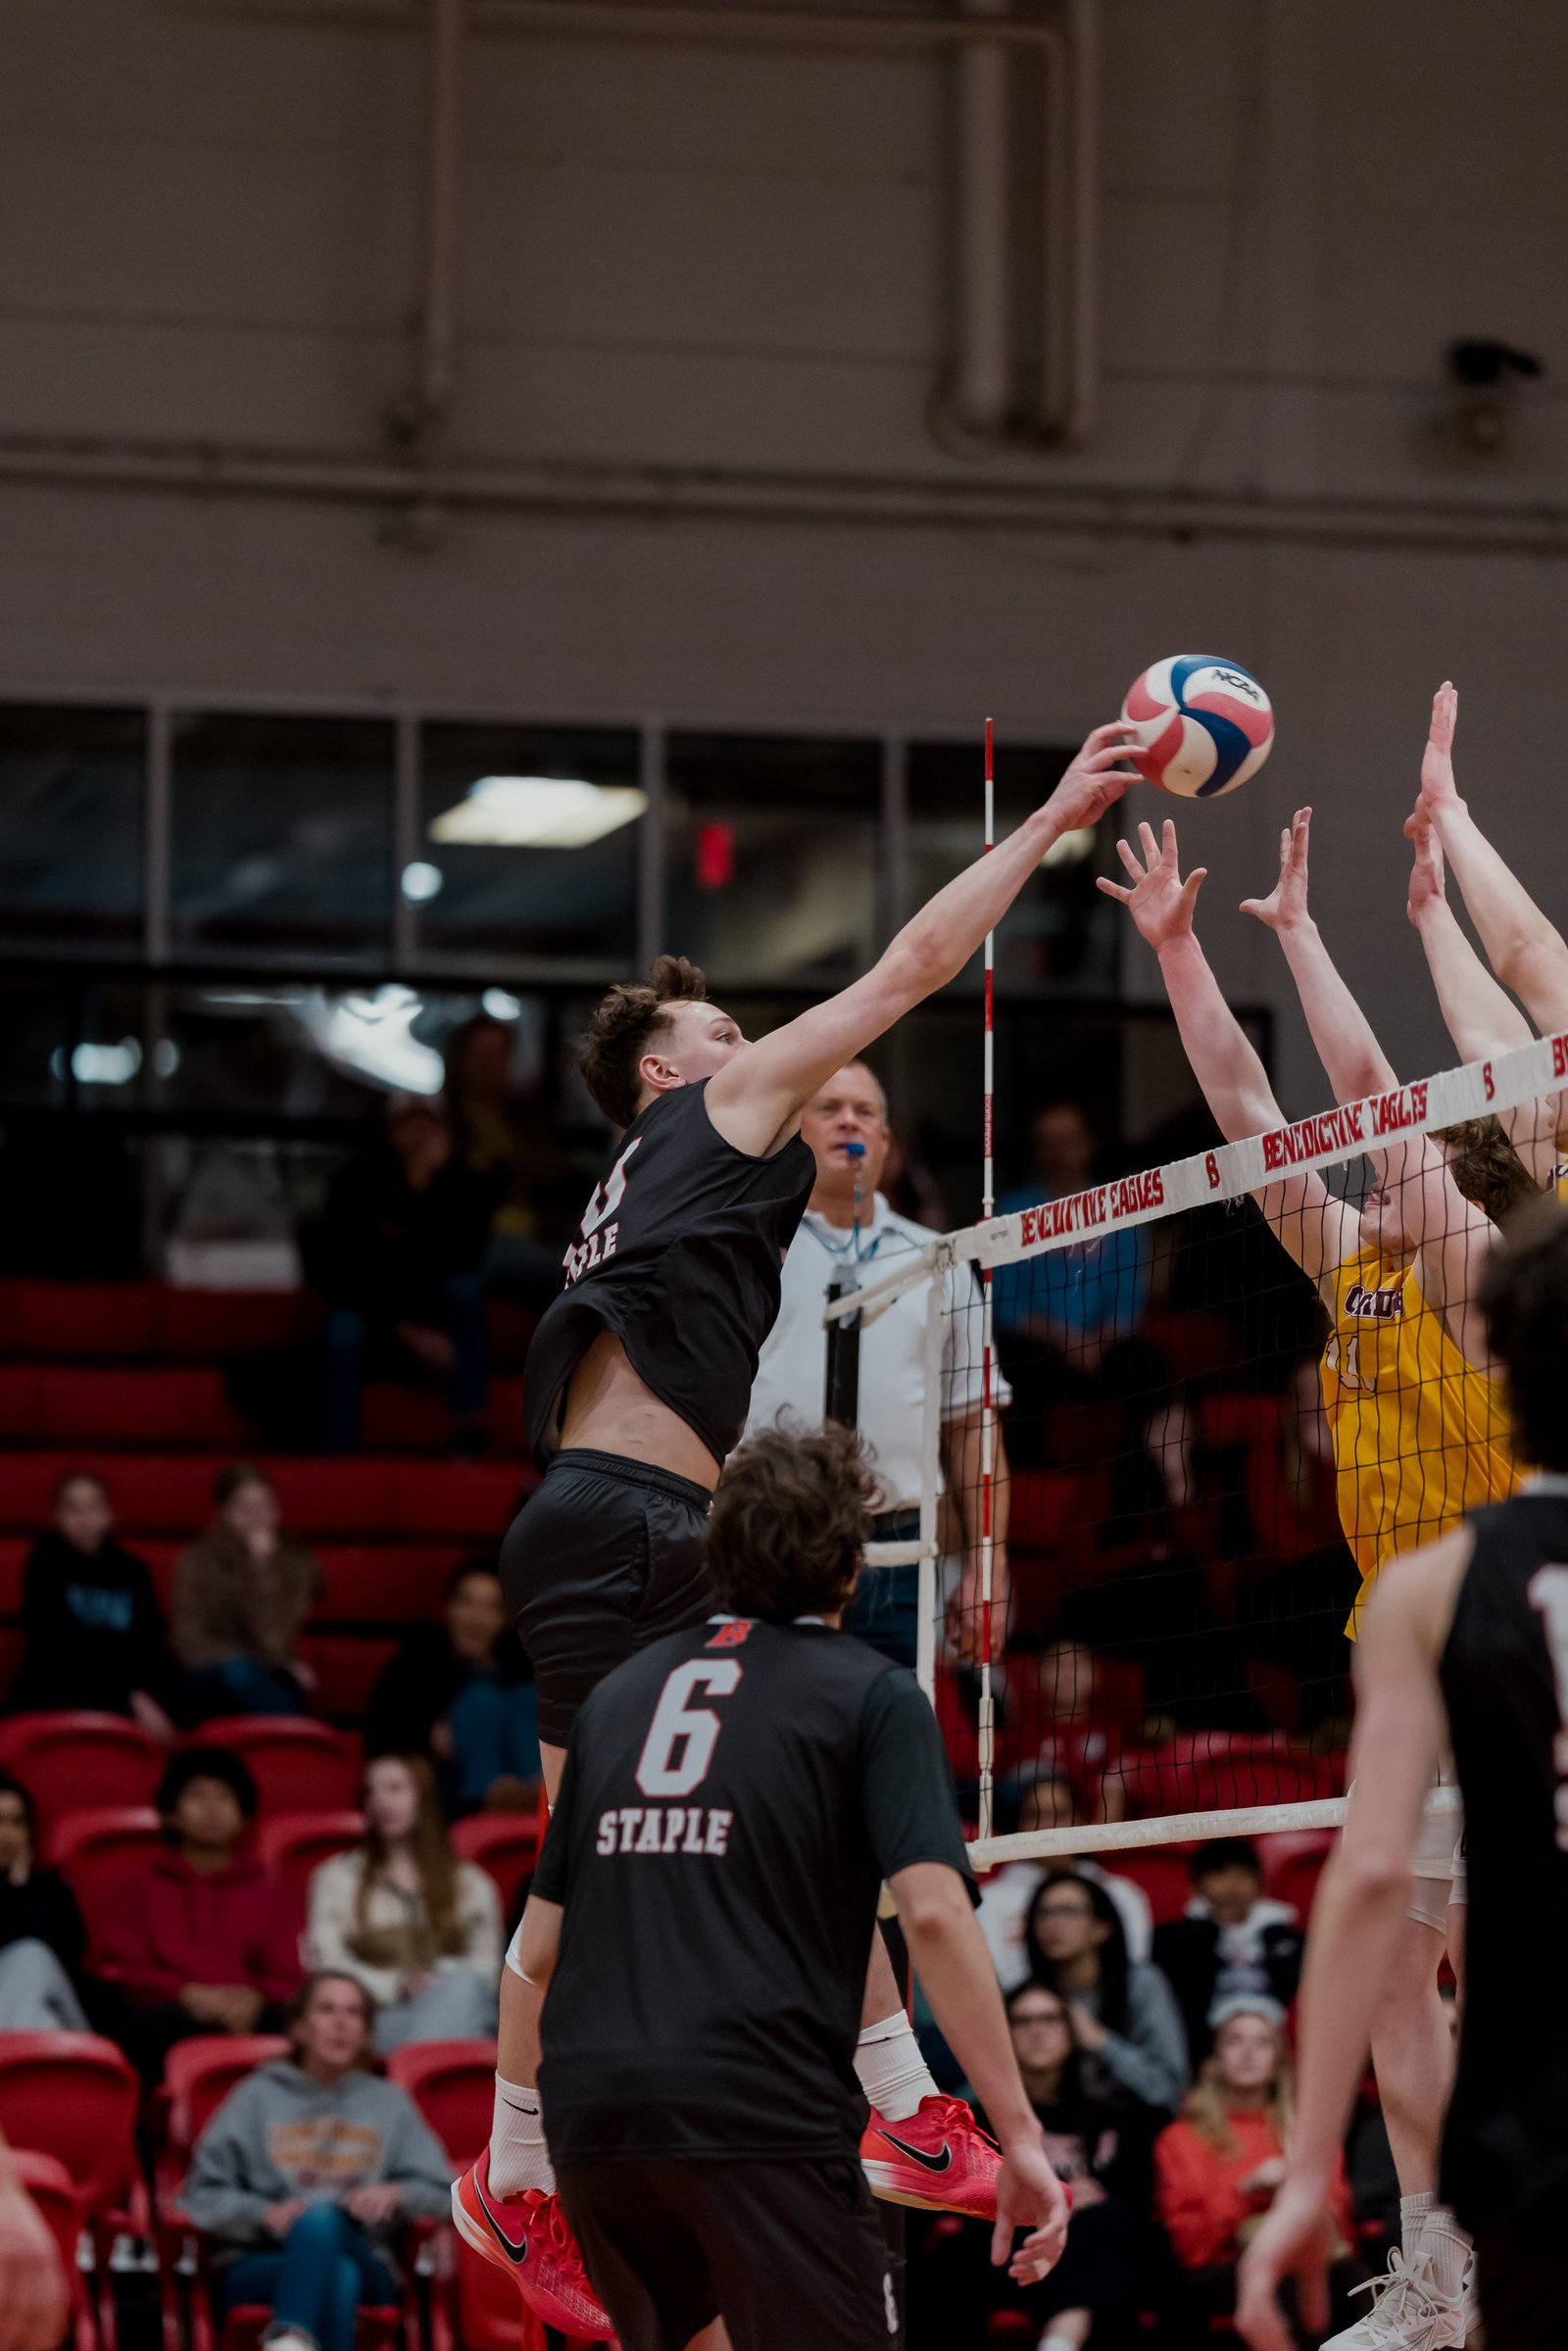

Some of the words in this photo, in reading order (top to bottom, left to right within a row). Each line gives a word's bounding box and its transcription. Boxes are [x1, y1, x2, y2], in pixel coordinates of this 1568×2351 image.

[1205, 1151, 1221, 1190] B
[705, 1620, 753, 1647] B
[635, 1657, 744, 1798] 6
[596, 1807, 734, 1857] STAPLE
